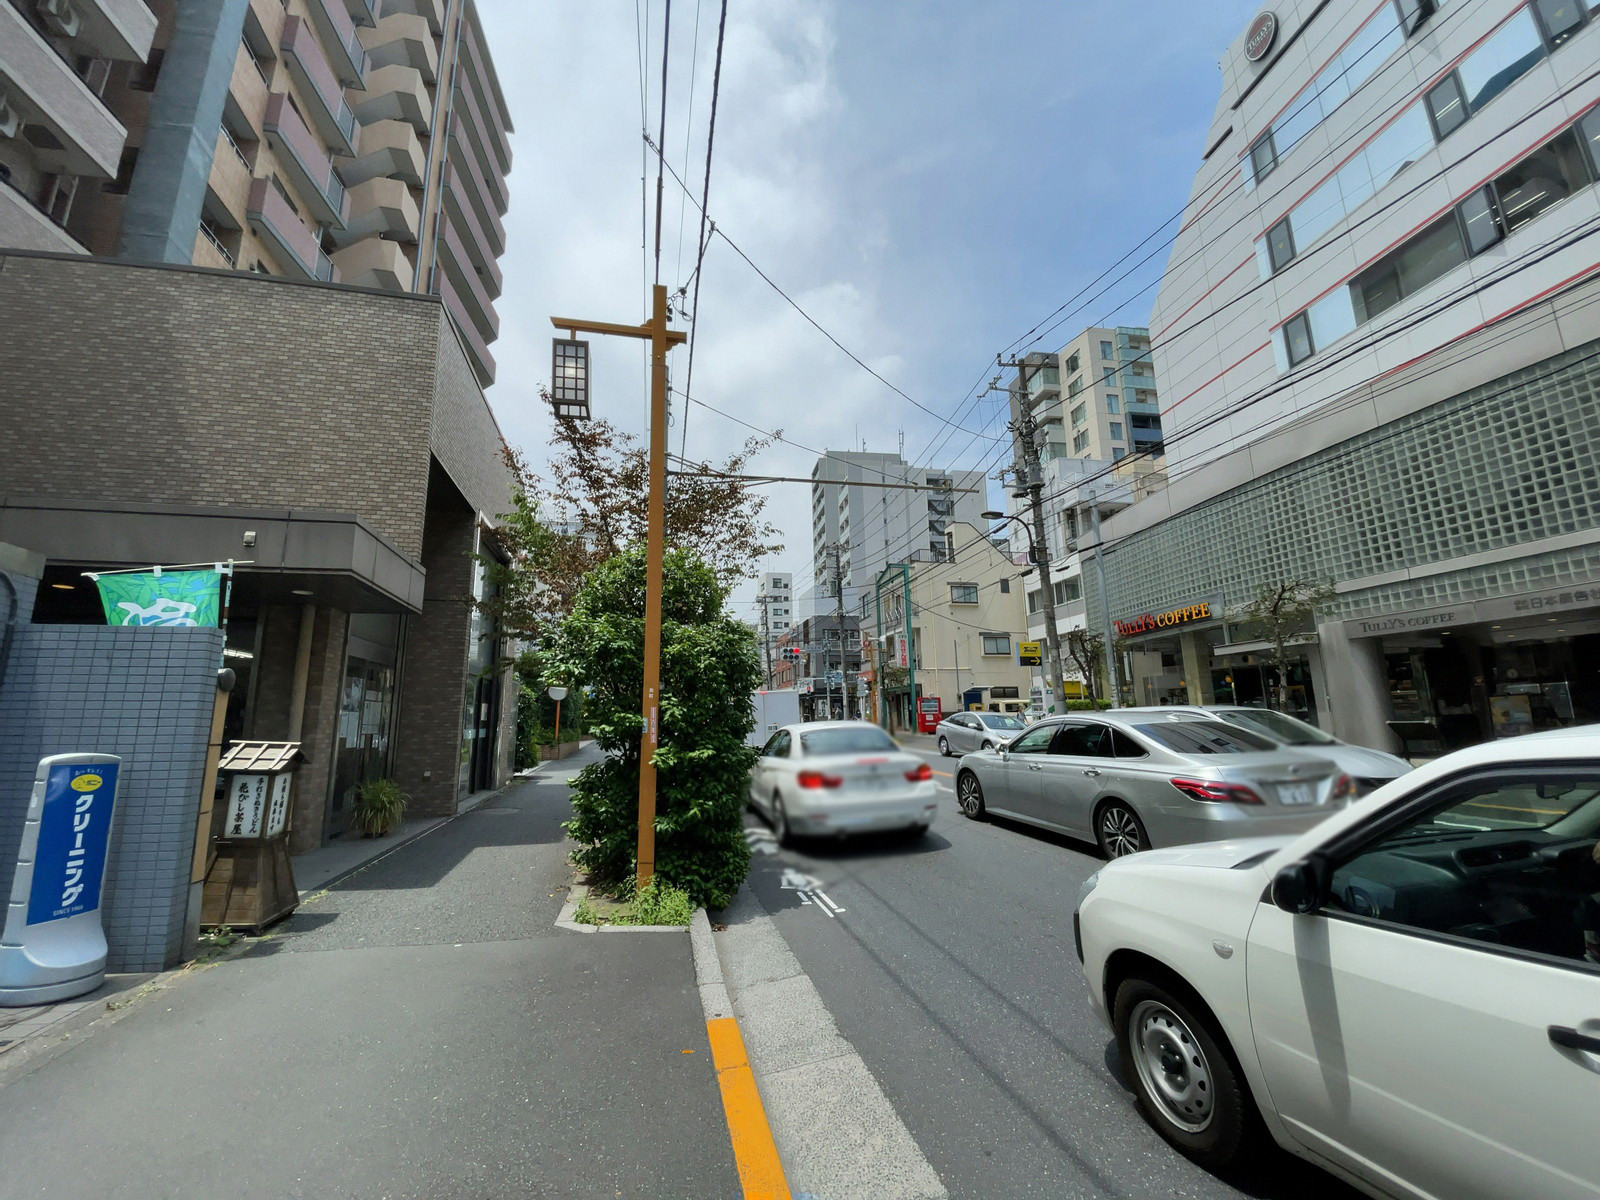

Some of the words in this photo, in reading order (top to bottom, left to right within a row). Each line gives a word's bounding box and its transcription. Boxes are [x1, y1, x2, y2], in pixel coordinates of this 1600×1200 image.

[1157, 602, 1212, 627] COFFEE
[1408, 612, 1456, 627] COFFEE
[231, 783, 249, 834] 花びし茶屋
[62, 794, 94, 907] クリーニング
